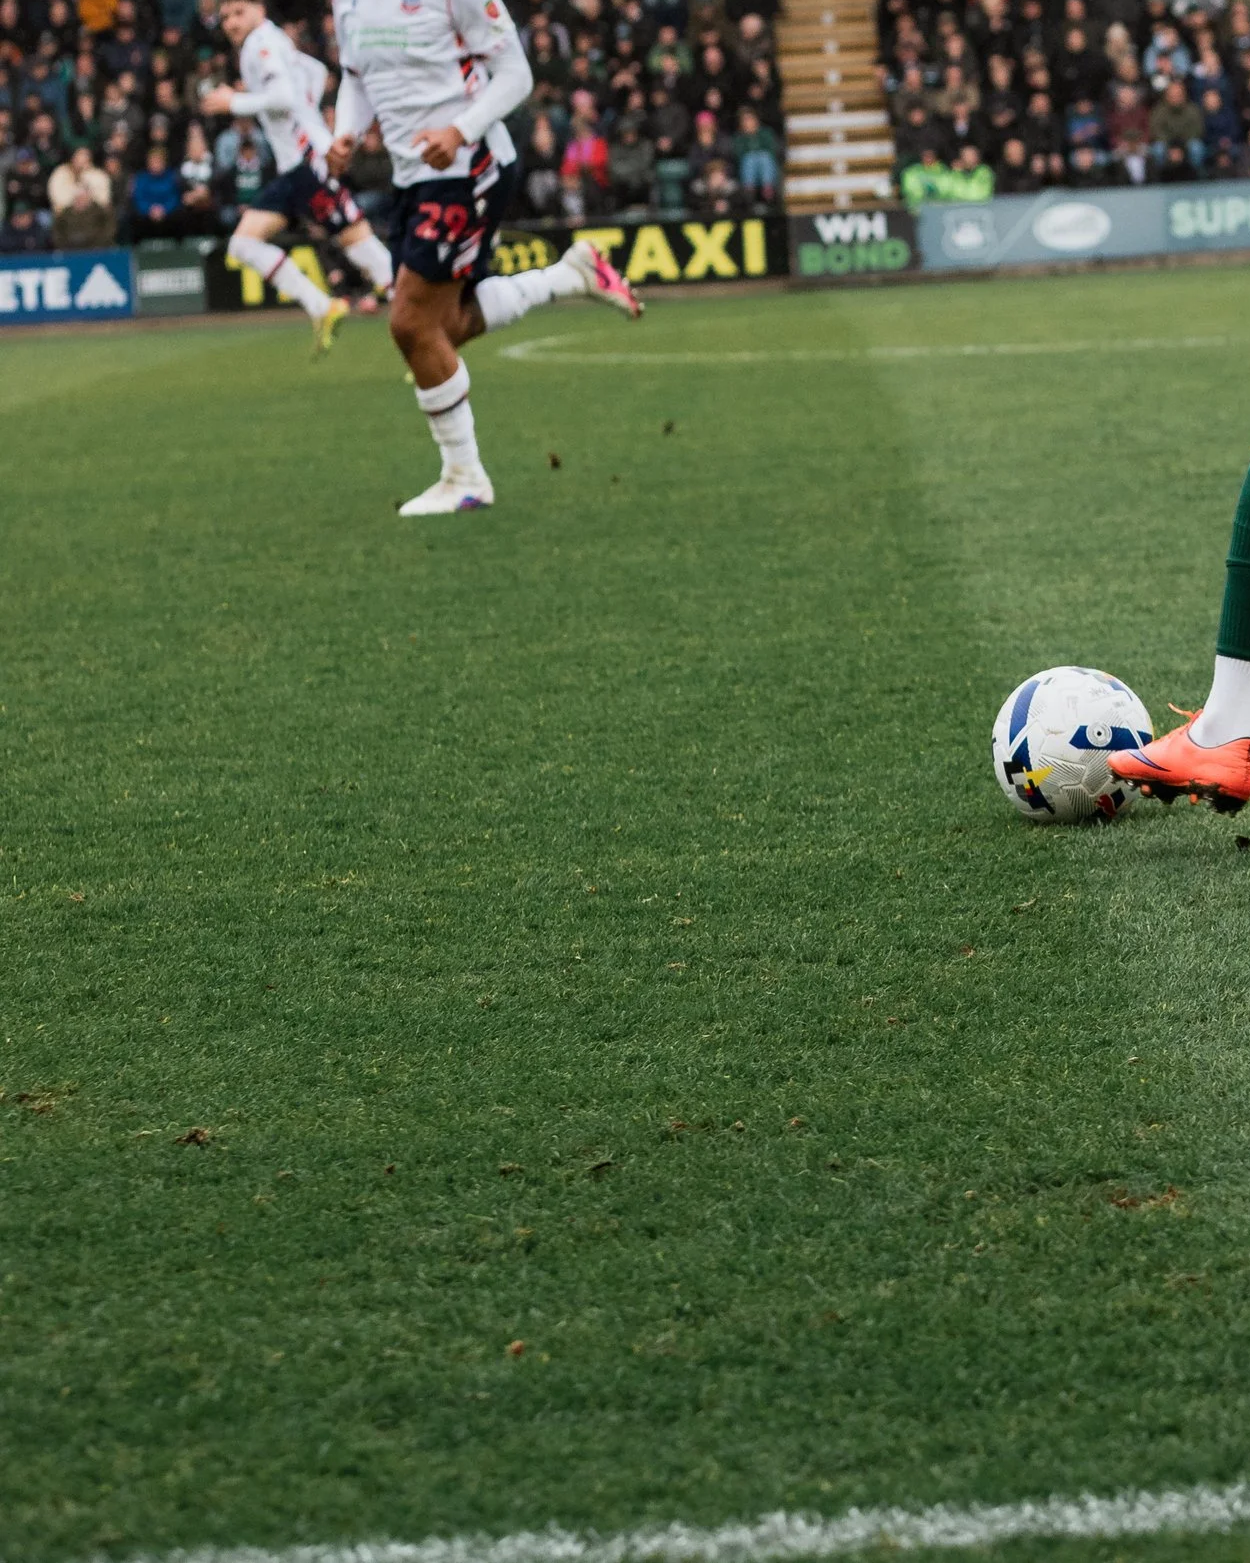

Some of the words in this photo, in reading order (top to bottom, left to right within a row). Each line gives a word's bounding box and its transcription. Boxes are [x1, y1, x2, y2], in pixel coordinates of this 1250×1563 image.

[415, 201, 469, 243] 29
[814, 211, 888, 244] WH
[571, 218, 768, 284] TAXI
[797, 239, 911, 276] BOND
